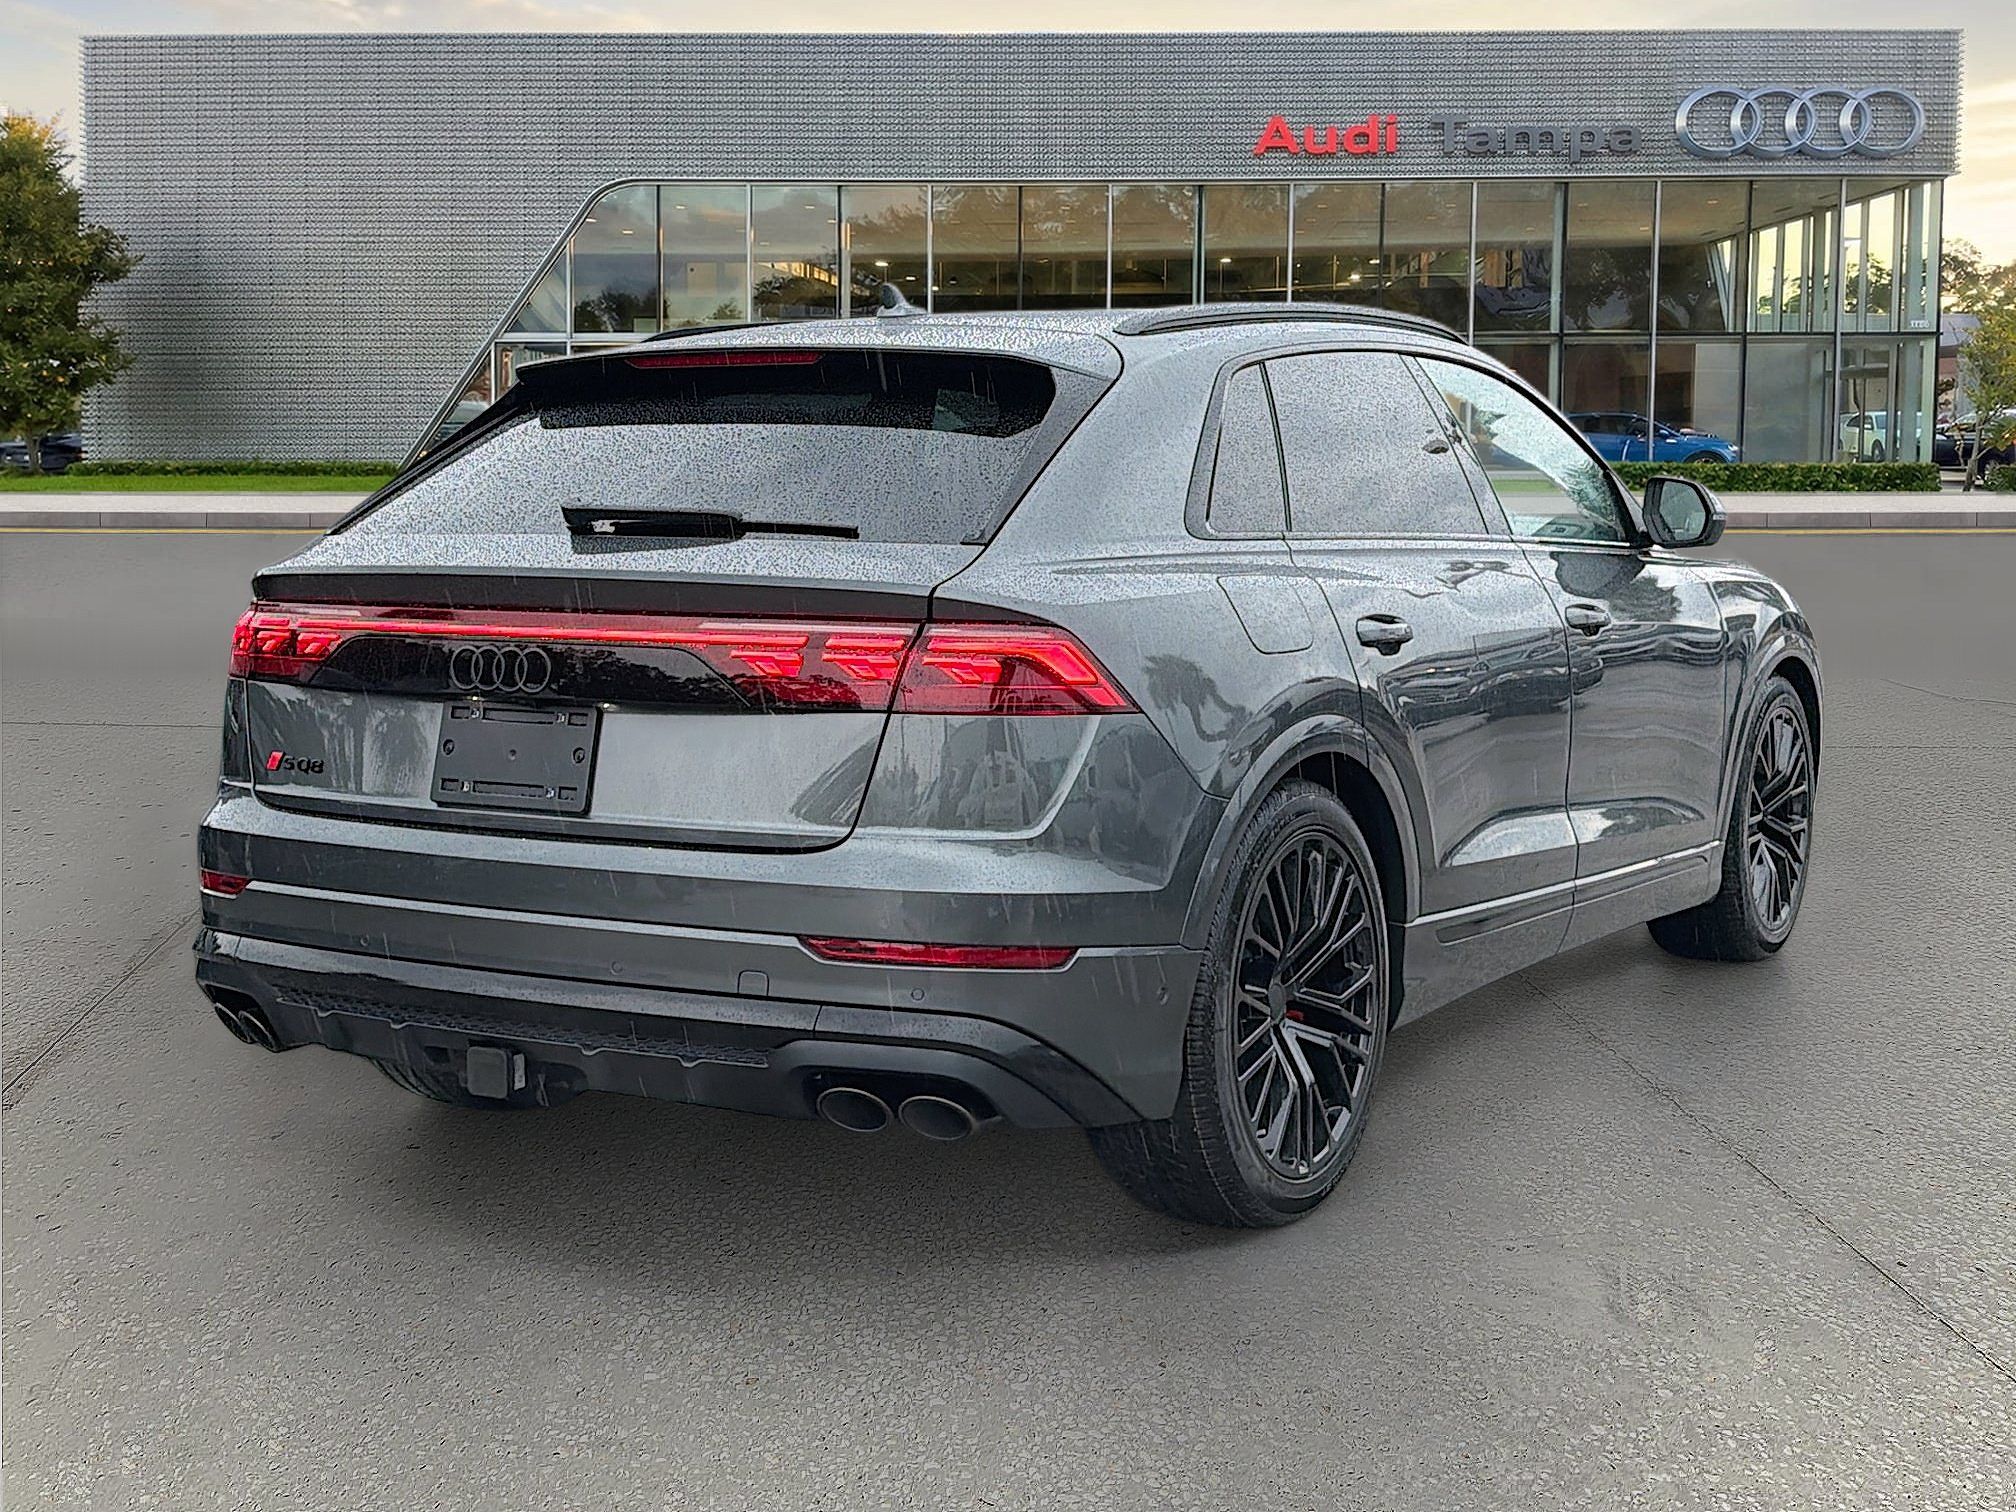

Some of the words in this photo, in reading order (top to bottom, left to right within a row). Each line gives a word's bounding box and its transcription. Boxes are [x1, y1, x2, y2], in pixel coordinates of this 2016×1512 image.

[1253, 113, 1397, 155] Audi
[1431, 114, 1642, 162] Tampa
[282, 756, 325, 775] SQ8
